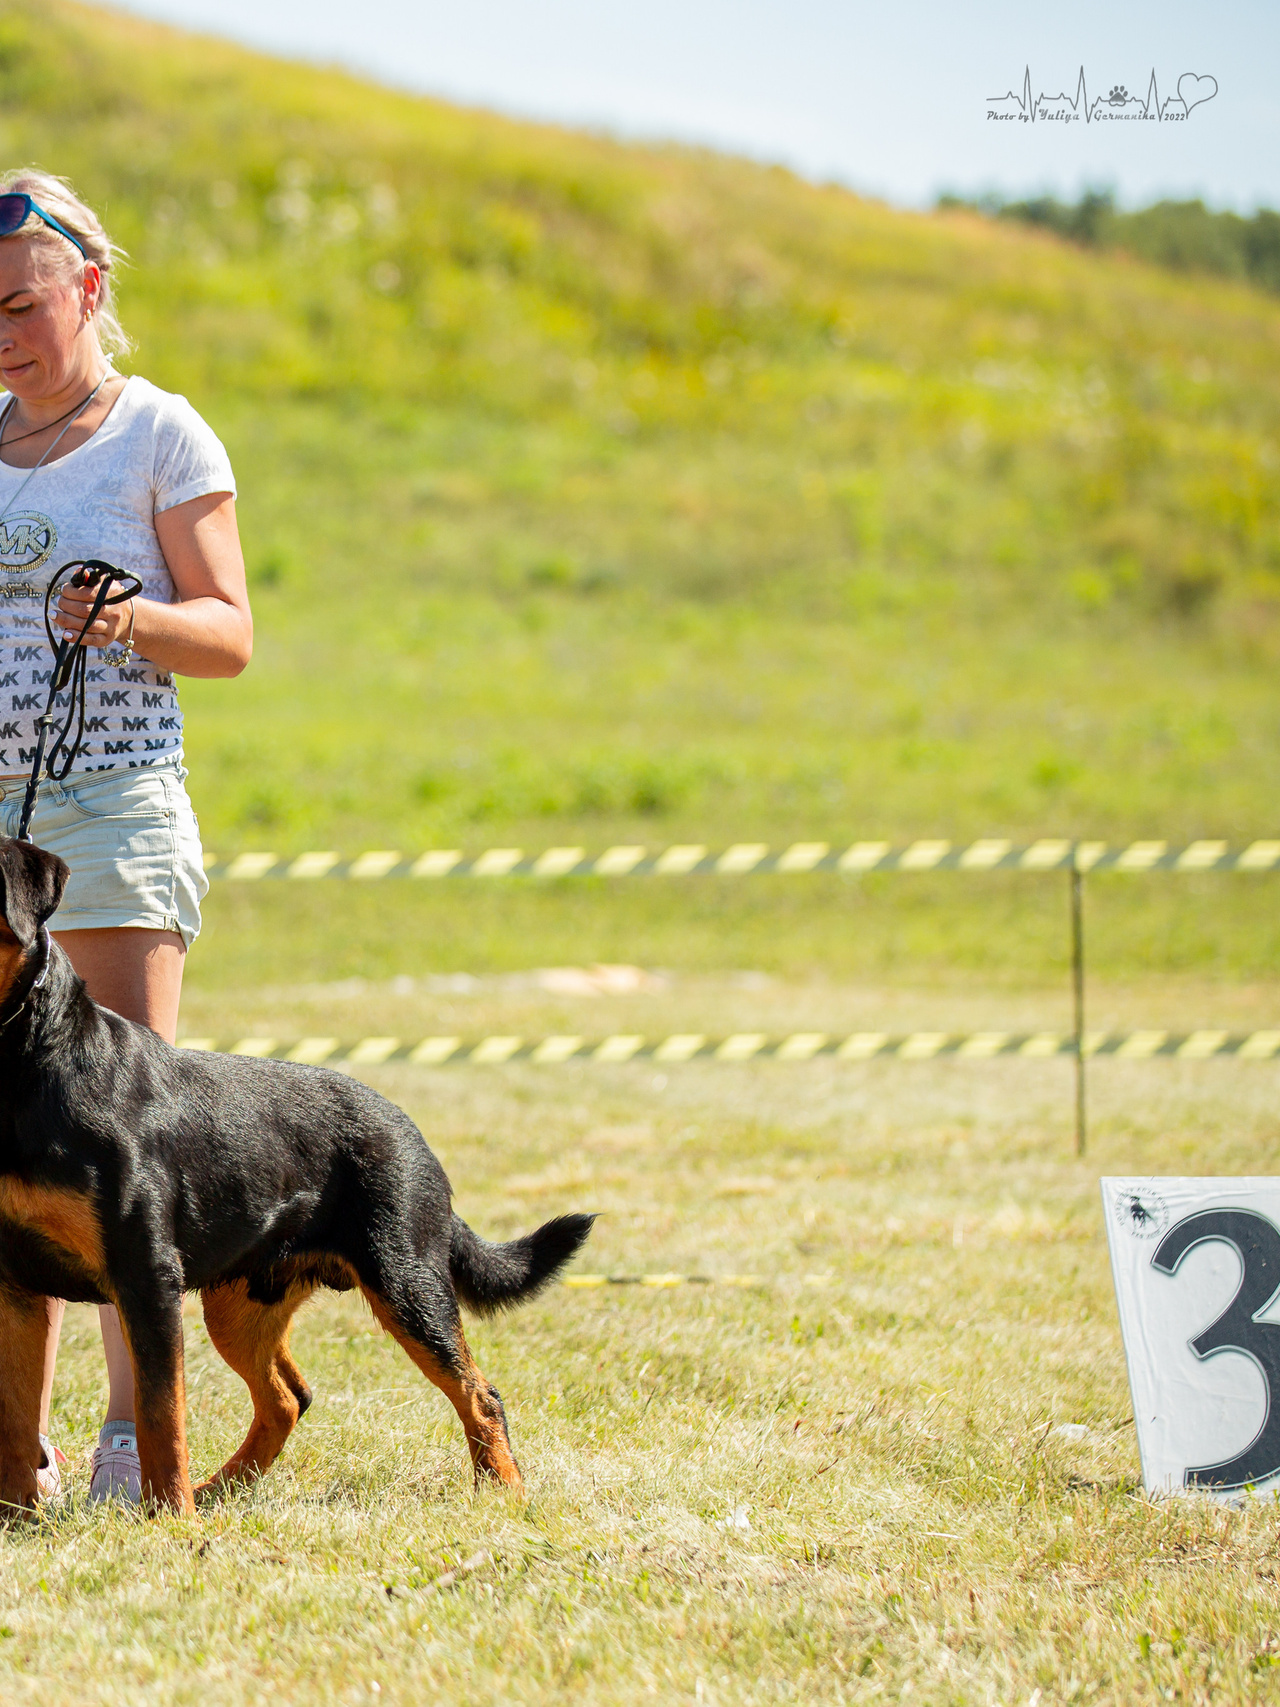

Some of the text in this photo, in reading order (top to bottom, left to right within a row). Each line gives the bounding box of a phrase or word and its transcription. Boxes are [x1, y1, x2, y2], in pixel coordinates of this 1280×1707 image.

[14, 646, 43, 662] MK
[119, 667, 147, 684] MK
[11, 693, 43, 711] MK
[100, 690, 131, 707] MK
[142, 691, 164, 709] MK
[121, 716, 150, 731] MK
[158, 716, 181, 730] MK
[104, 740, 134, 755] MK
[1149, 1206, 1280, 1490] 3
